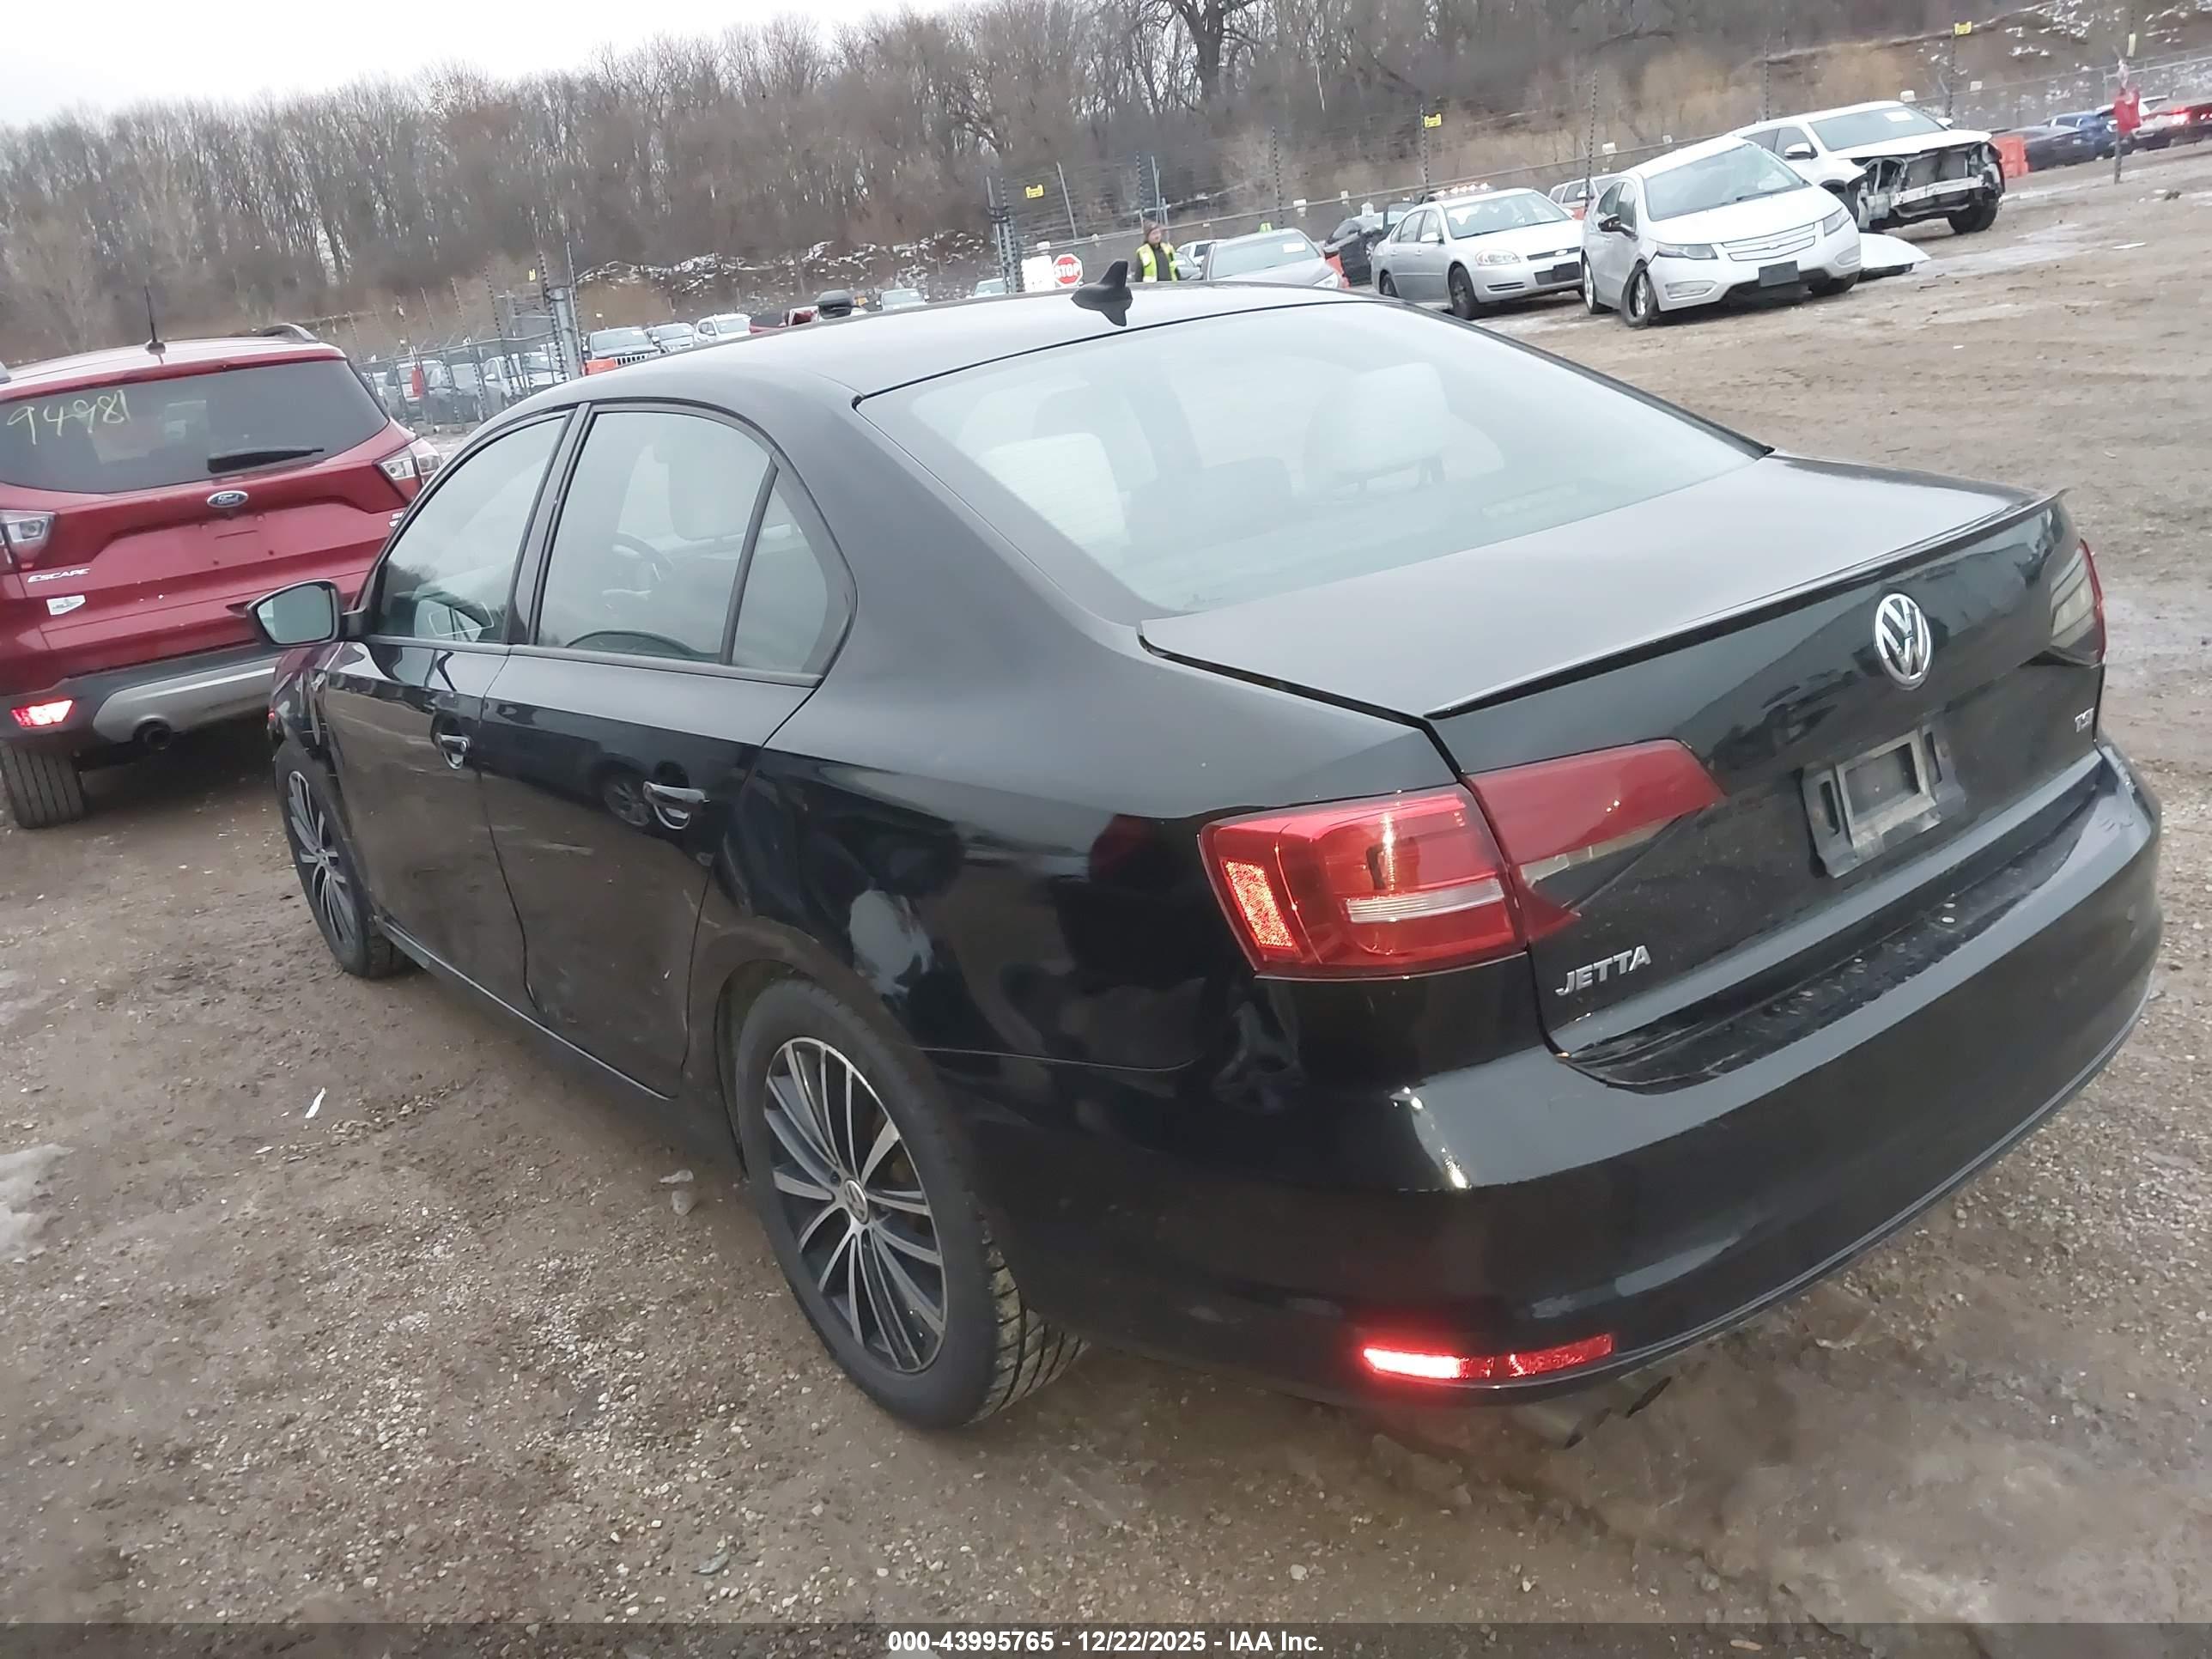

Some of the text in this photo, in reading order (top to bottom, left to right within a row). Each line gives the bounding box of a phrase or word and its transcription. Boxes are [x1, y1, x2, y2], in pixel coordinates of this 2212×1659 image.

[1054, 263, 1081, 277] STOP
[6, 389, 131, 445] 94981
[27, 568, 91, 583] ESCAPE
[1555, 945, 1651, 996] JETTA
